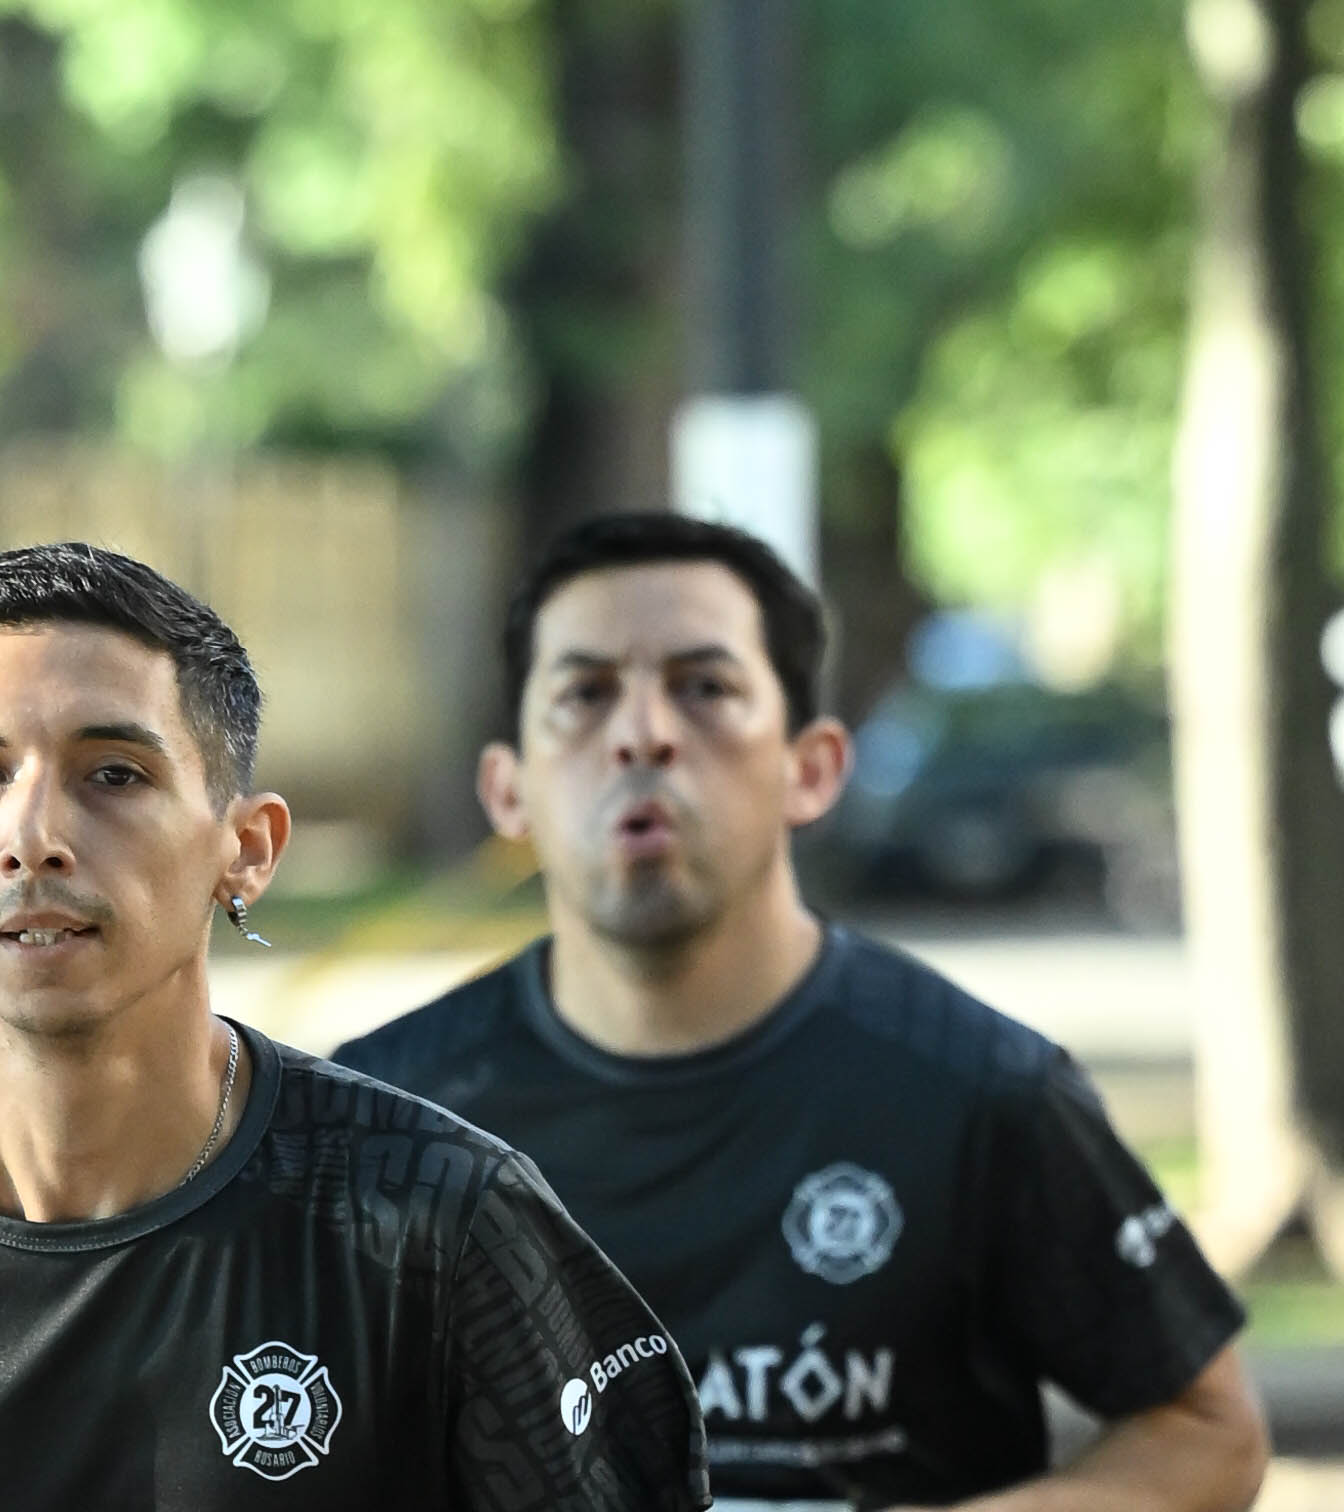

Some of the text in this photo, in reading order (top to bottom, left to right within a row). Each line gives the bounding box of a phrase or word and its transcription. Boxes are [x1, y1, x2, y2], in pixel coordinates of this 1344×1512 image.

[590, 1334, 668, 1393] Banco
[699, 1322, 896, 1423] ATÓN
[253, 1383, 302, 1430] 27
